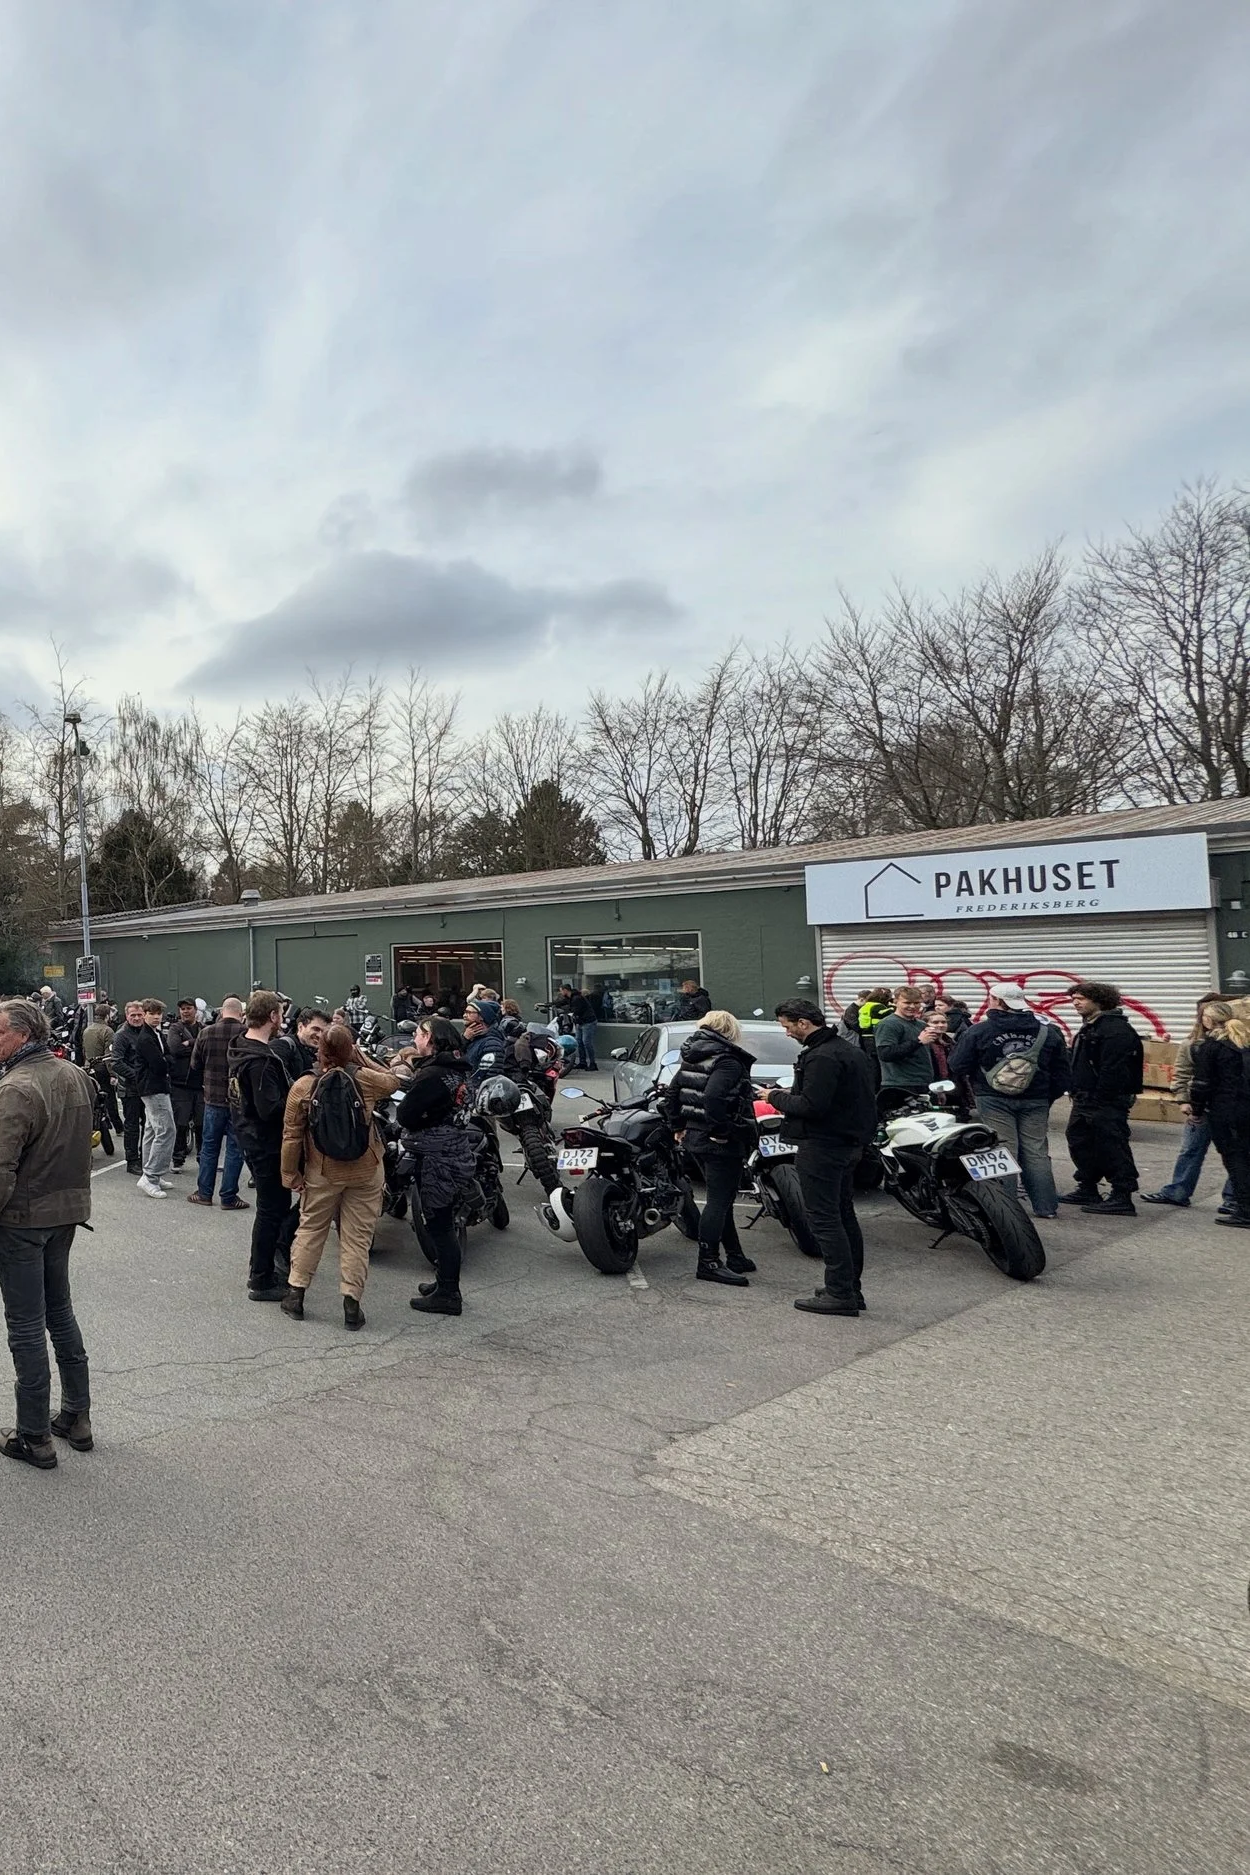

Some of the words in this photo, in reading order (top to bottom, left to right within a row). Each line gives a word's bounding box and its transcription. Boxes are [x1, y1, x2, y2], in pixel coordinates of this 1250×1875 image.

[934, 859, 1120, 898] PAKHUSET
[956, 899, 1100, 913] FREDERIKSBERG
[566, 1158, 588, 1167] 419
[978, 1162, 1008, 1177] 779
